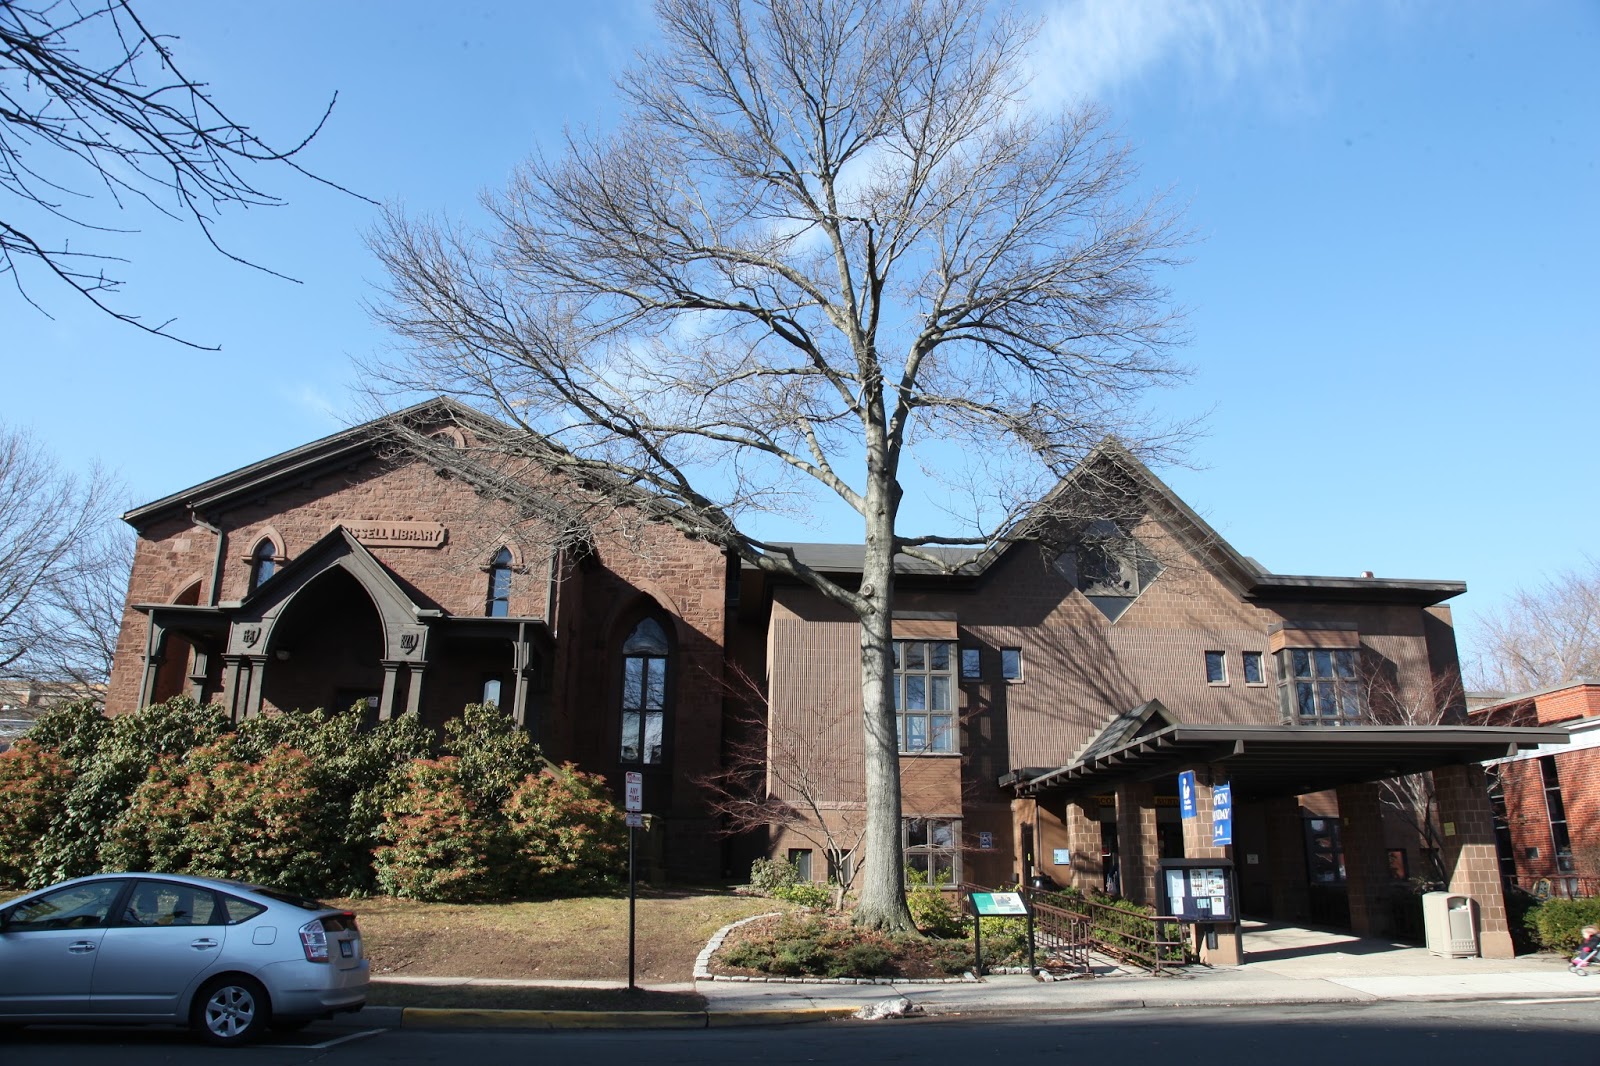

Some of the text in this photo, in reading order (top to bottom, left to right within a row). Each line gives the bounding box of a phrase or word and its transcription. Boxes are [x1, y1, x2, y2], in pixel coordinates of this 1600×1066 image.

[347, 526, 441, 541] SSELL LIBRARY
[630, 787, 638, 795] ANY
[629, 795, 640, 803] TIME
